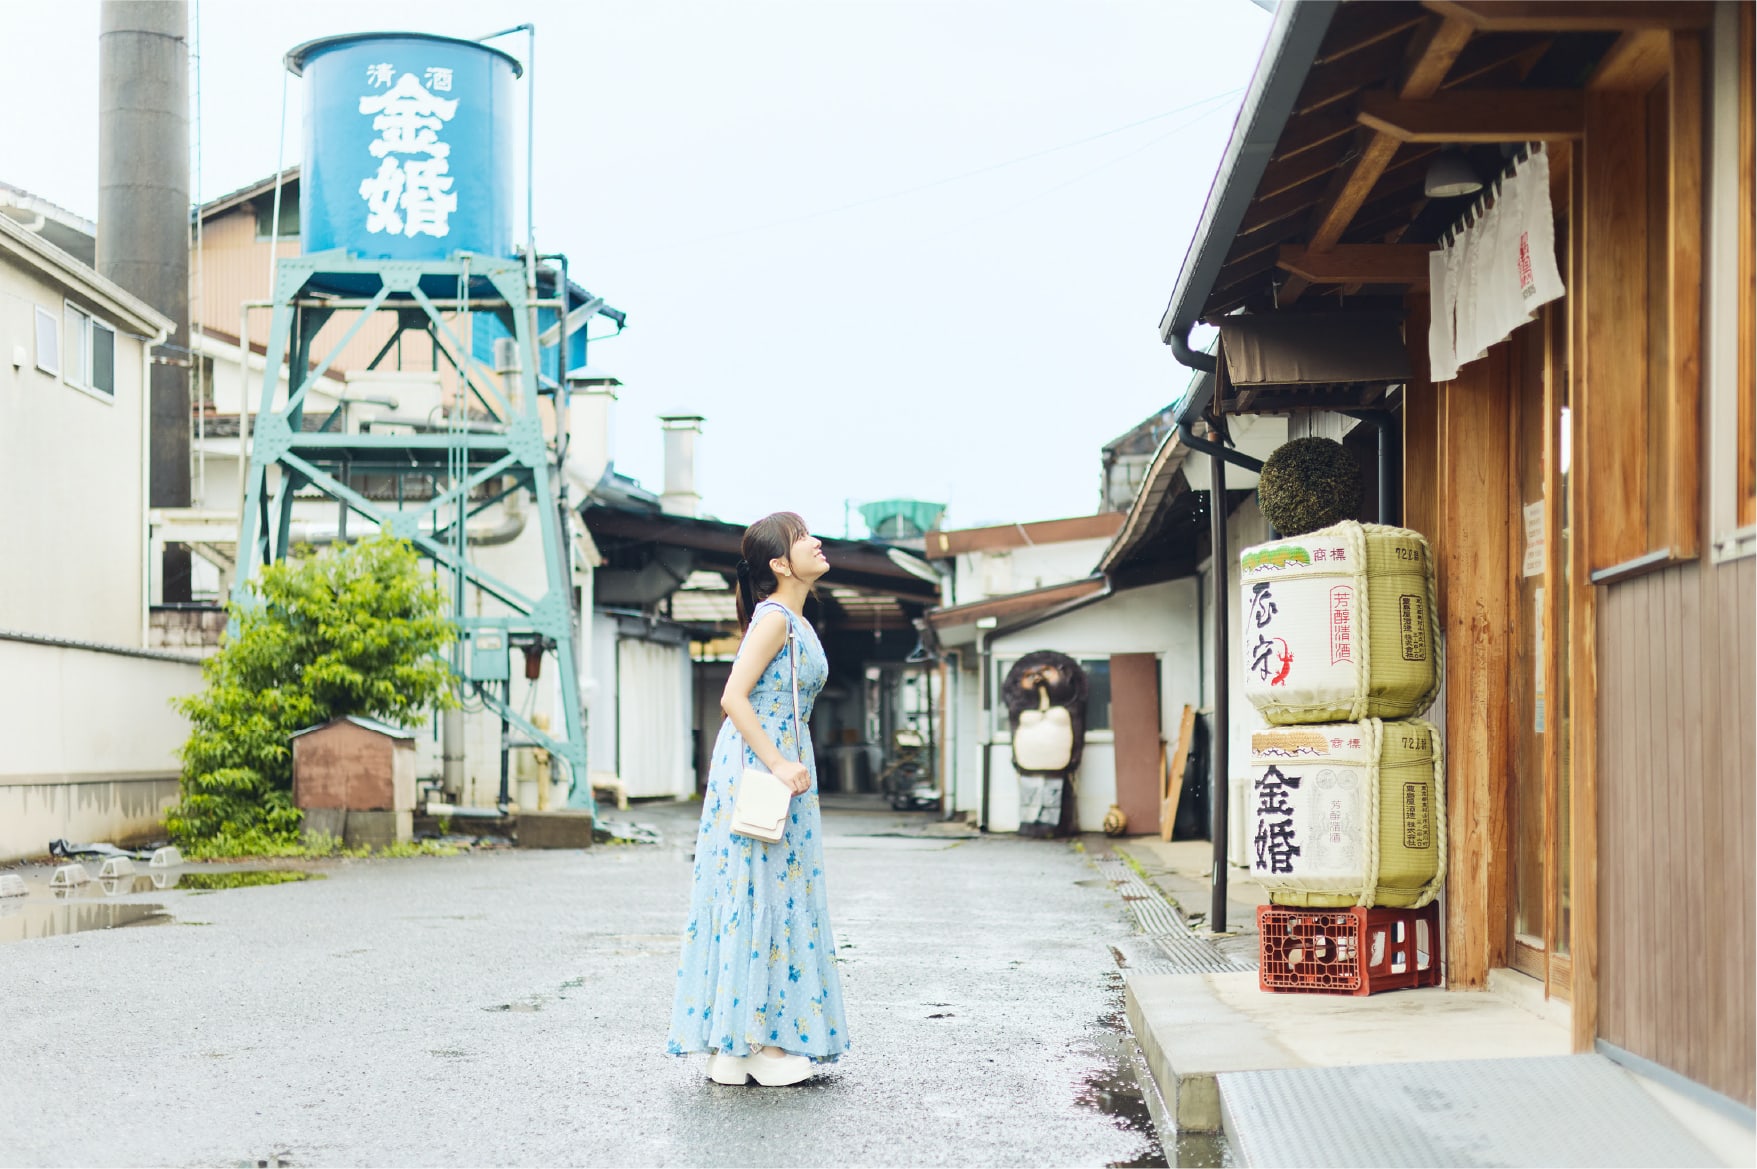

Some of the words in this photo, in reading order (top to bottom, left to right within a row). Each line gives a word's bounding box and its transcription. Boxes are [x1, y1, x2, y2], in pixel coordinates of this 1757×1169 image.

[366, 63, 453, 91] 清酒
[358, 72, 460, 239] 金婚
[1313, 548, 1346, 561] 商標
[1333, 591, 1350, 659] 芳醇清酒
[1330, 737, 1361, 749] 商標
[1254, 764, 1301, 875] 金婚
